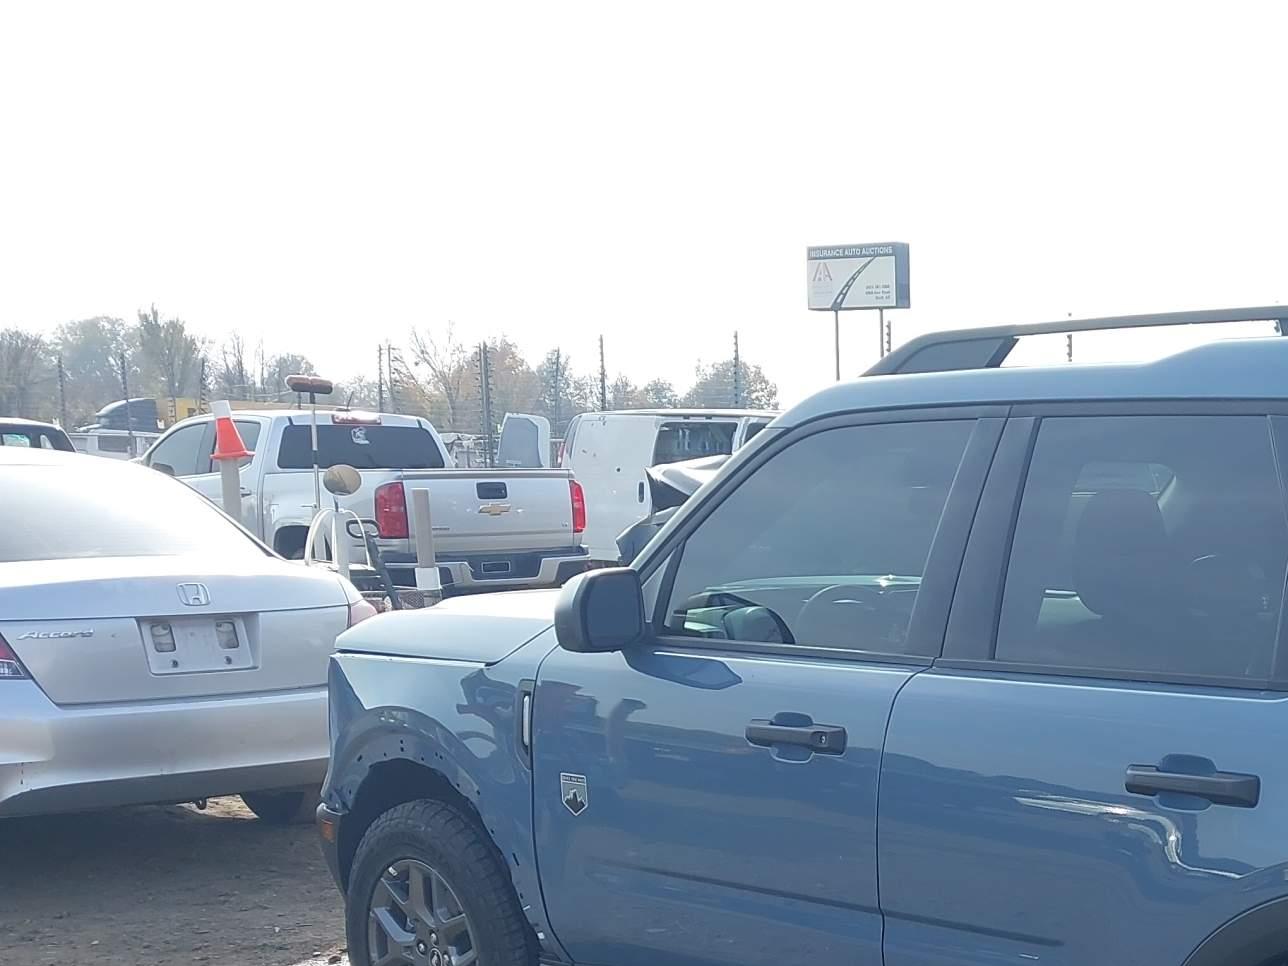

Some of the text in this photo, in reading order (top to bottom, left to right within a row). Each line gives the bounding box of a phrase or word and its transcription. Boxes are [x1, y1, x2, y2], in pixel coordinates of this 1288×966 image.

[809, 246, 893, 257] INSURANCE AUTO AUCTIONS
[16, 629, 95, 641] Accord
